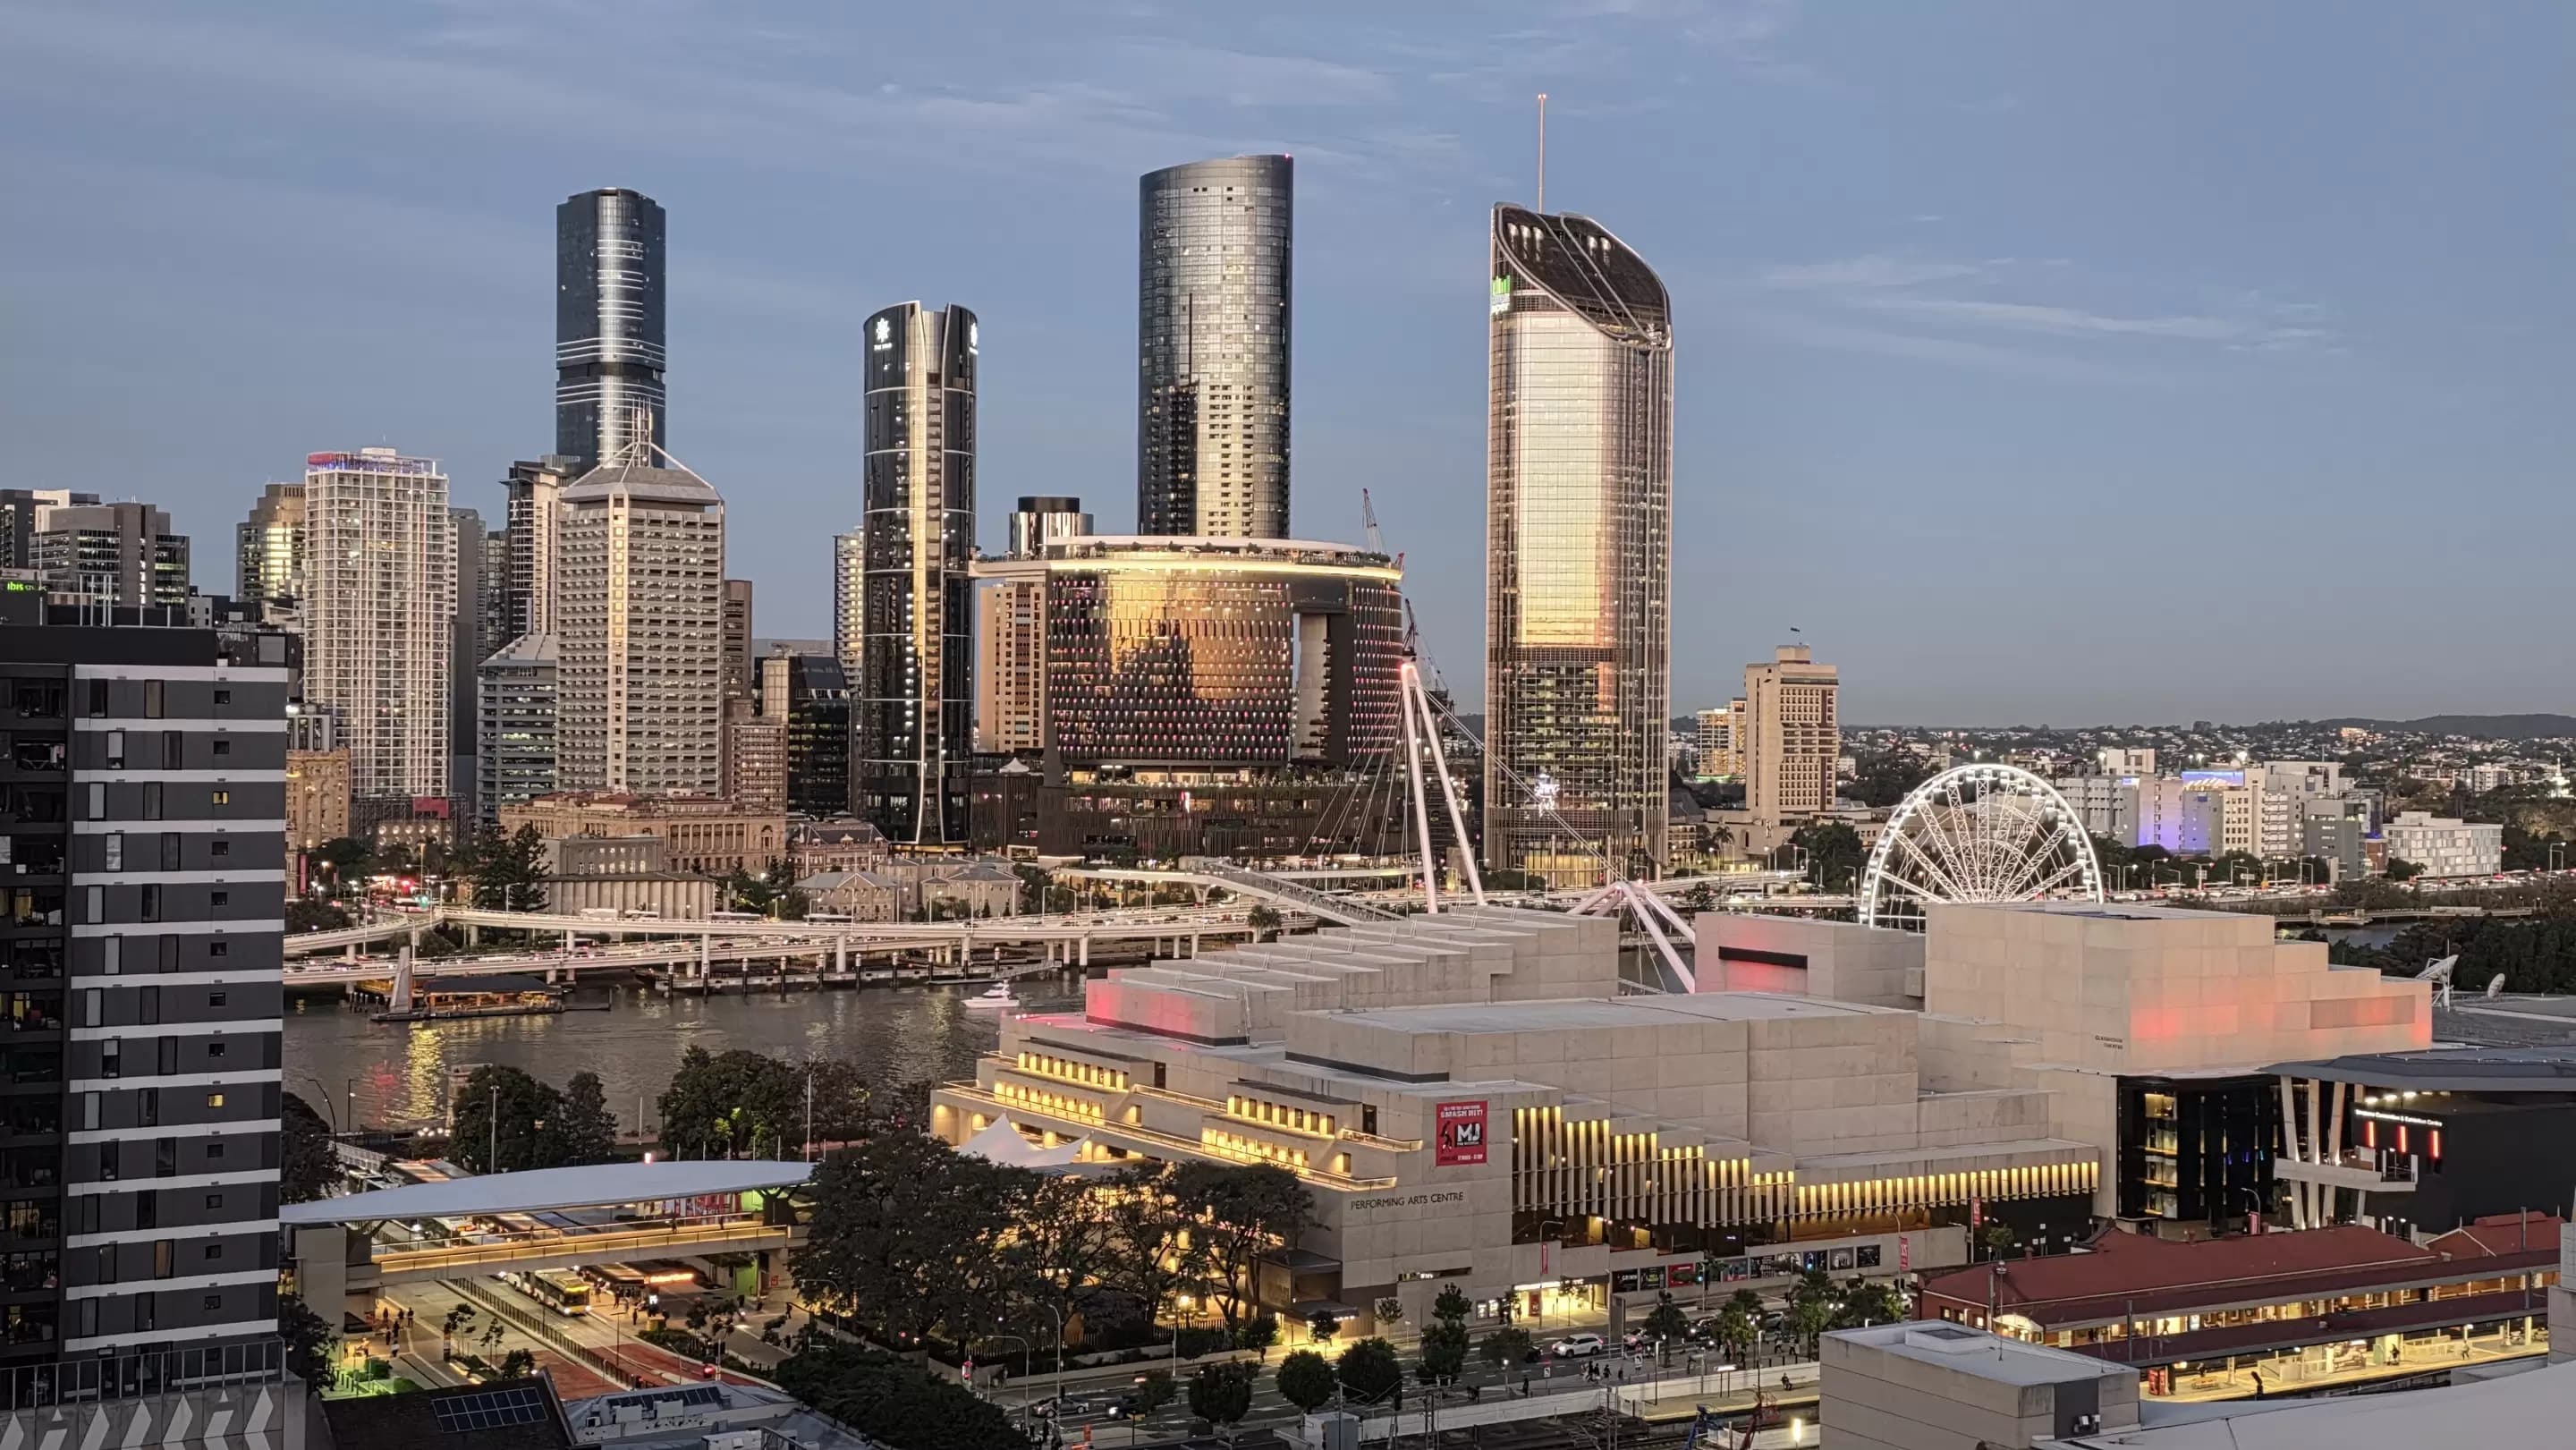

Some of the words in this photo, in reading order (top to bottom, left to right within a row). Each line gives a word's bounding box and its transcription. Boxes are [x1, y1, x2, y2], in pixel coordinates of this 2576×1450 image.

[7, 581, 23, 590] ibis
[1457, 1123, 1480, 1142] MJ
[1351, 1197, 1405, 1209] PERFORMING
[1408, 1195, 1428, 1205] ARTS
[1430, 1191, 1464, 1203] CENTRE
